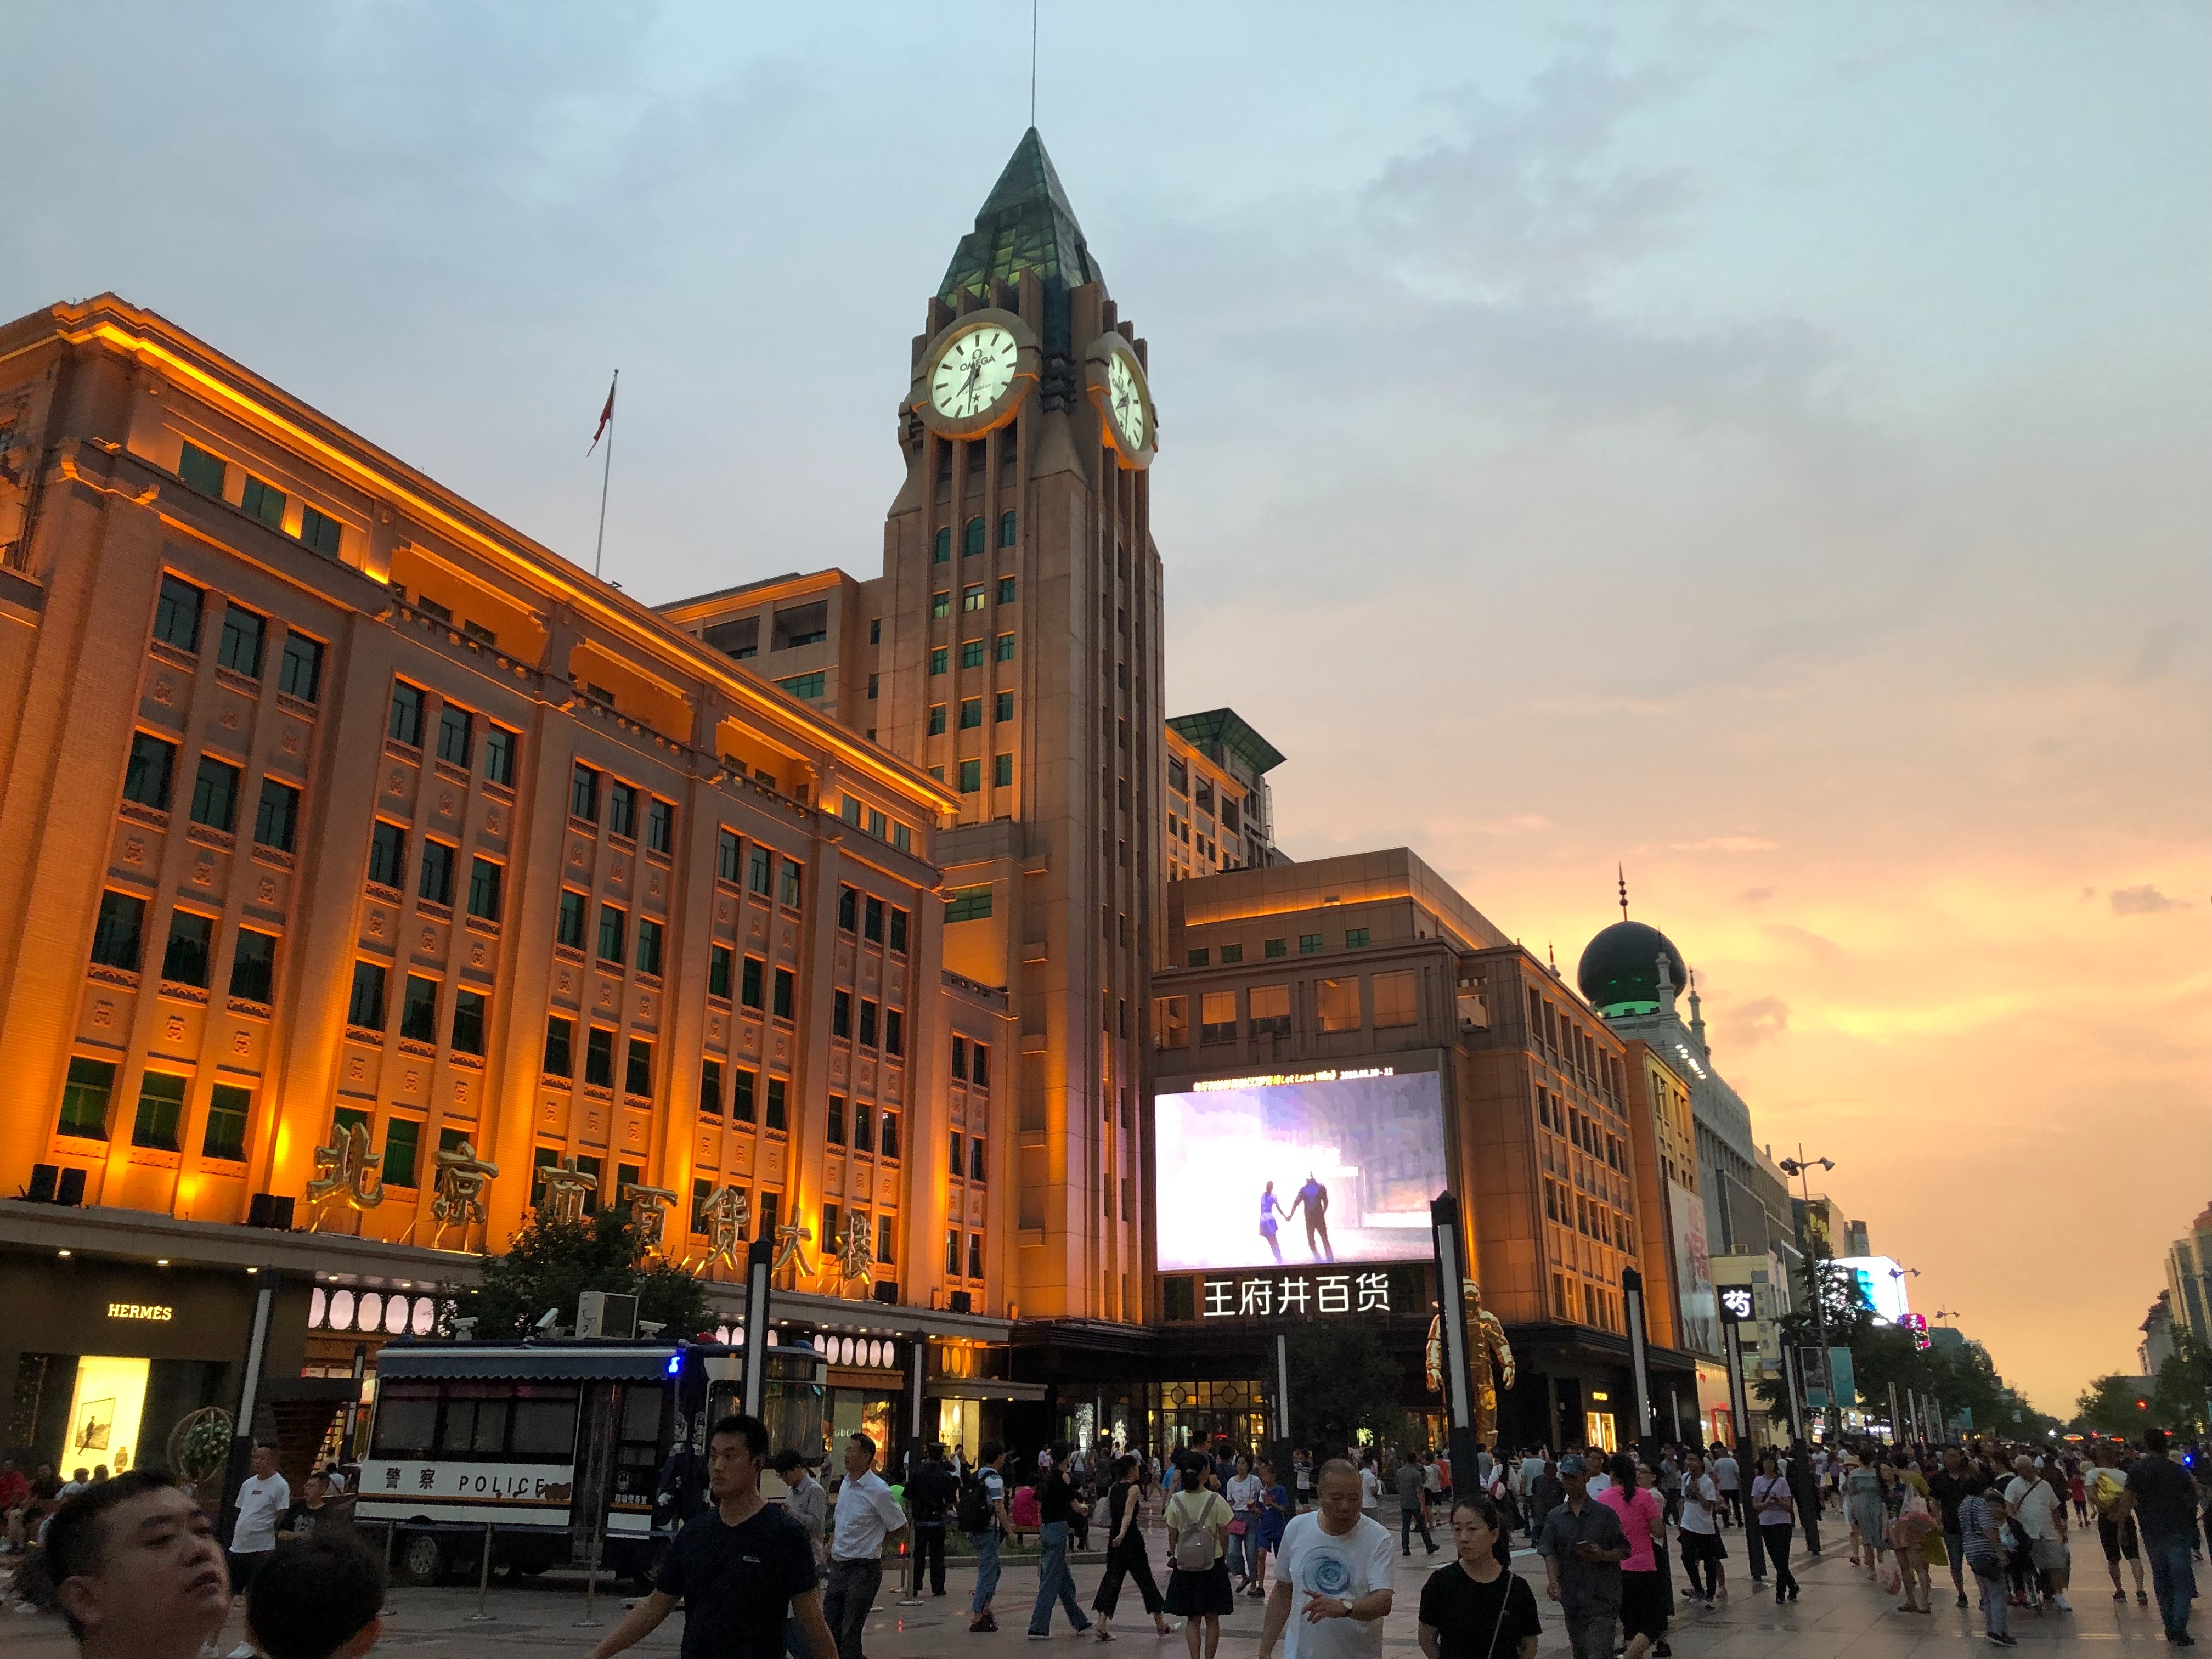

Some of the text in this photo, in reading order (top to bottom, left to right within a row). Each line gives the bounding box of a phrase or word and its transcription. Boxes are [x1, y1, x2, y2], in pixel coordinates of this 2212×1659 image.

[960, 354, 996, 371] OMEGA
[1203, 1273, 1391, 1317] 王府井百货
[1723, 1290, 1751, 1317] 药
[386, 1466, 436, 1489] 警察
[459, 1476, 545, 1493] POLICE
